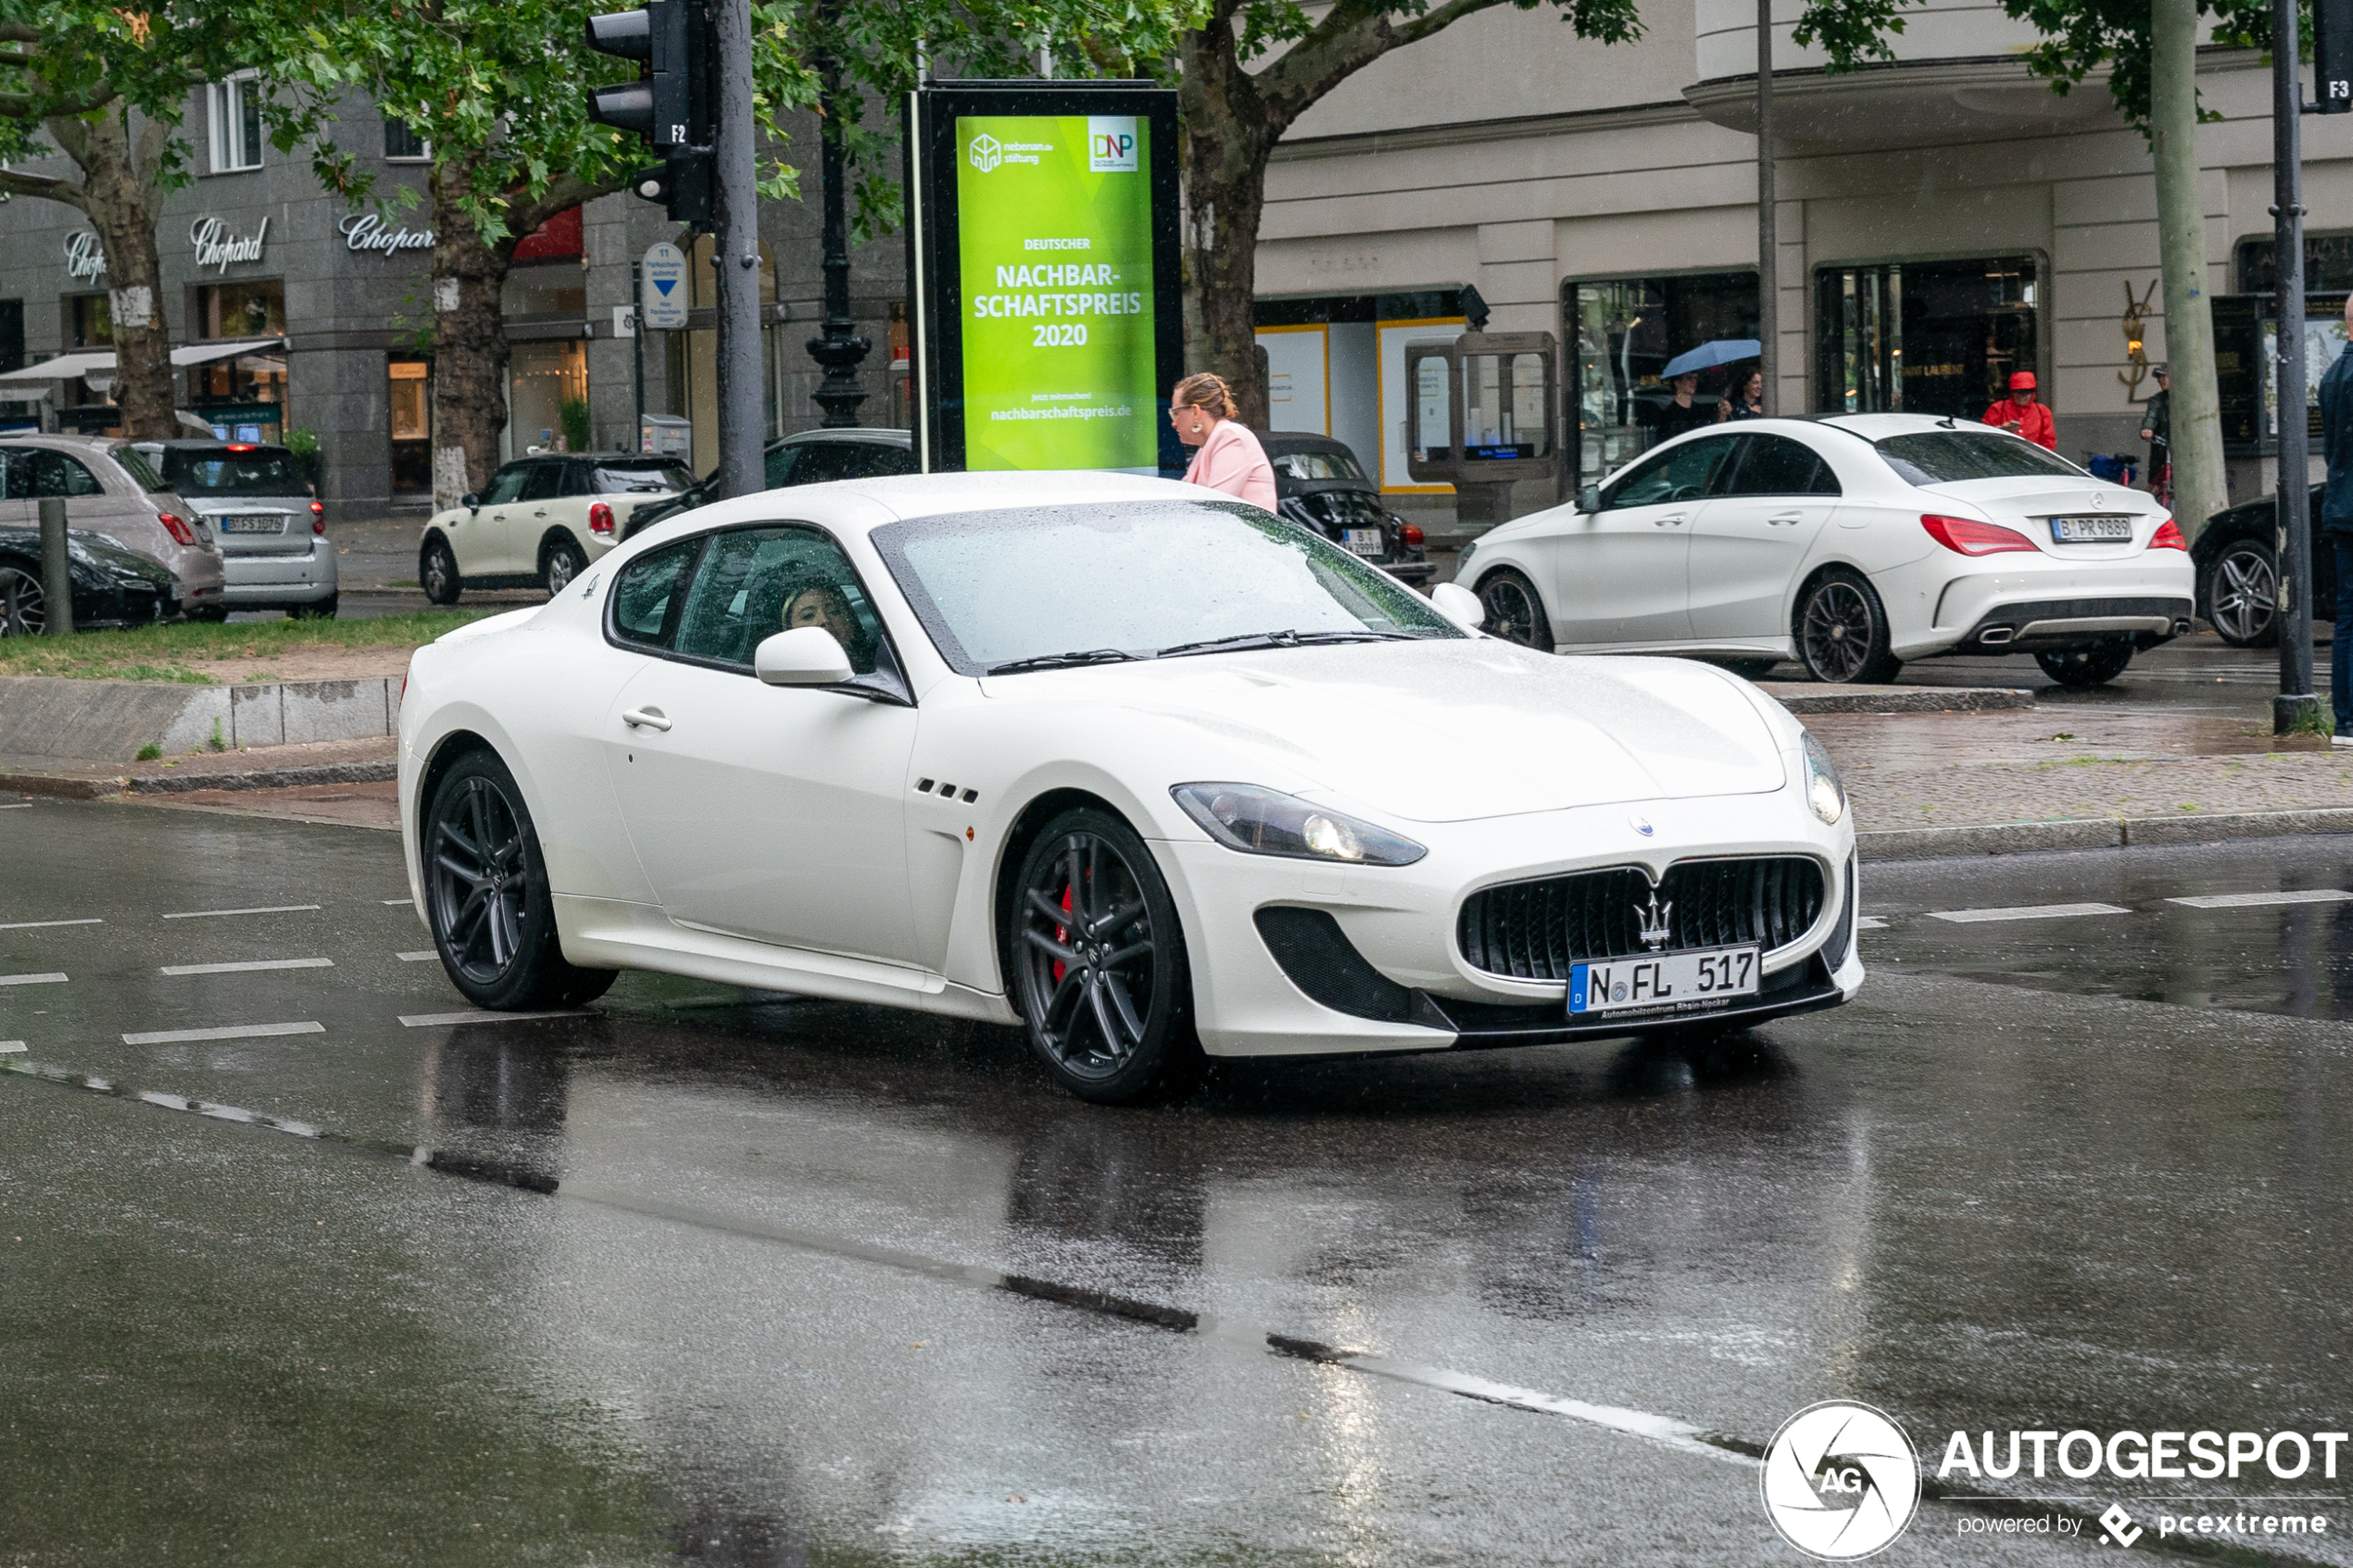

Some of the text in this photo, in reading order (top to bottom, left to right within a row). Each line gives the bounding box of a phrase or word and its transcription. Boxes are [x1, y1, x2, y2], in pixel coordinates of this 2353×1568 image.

[2329, 81, 2349, 98] F3
[672, 125, 686, 143] F2
[1003, 142, 1054, 152] nebenan.de
[1094, 134, 1133, 157] DNP
[1003, 153, 1039, 166] stiftung
[339, 214, 436, 257] Chopar
[1024, 238, 1091, 250] DEUTSCHER
[190, 216, 268, 274] Chopard
[996, 264, 1121, 288] NACHBAR-
[974, 292, 1141, 318] SCHAFTSPREIS
[1033, 324, 1088, 346] 2020
[990, 406, 1131, 420] nachbarschaftspreis.de
[2061, 520, 2129, 535] B PR 9889
[1357, 532, 1364, 542] B
[1591, 952, 1754, 1004] N FL 517
[1575, 993, 1582, 1004] D
[1602, 1006, 1675, 1019] Automobilzentrum
[1677, 998, 1730, 1010] Rhein-Neckar
